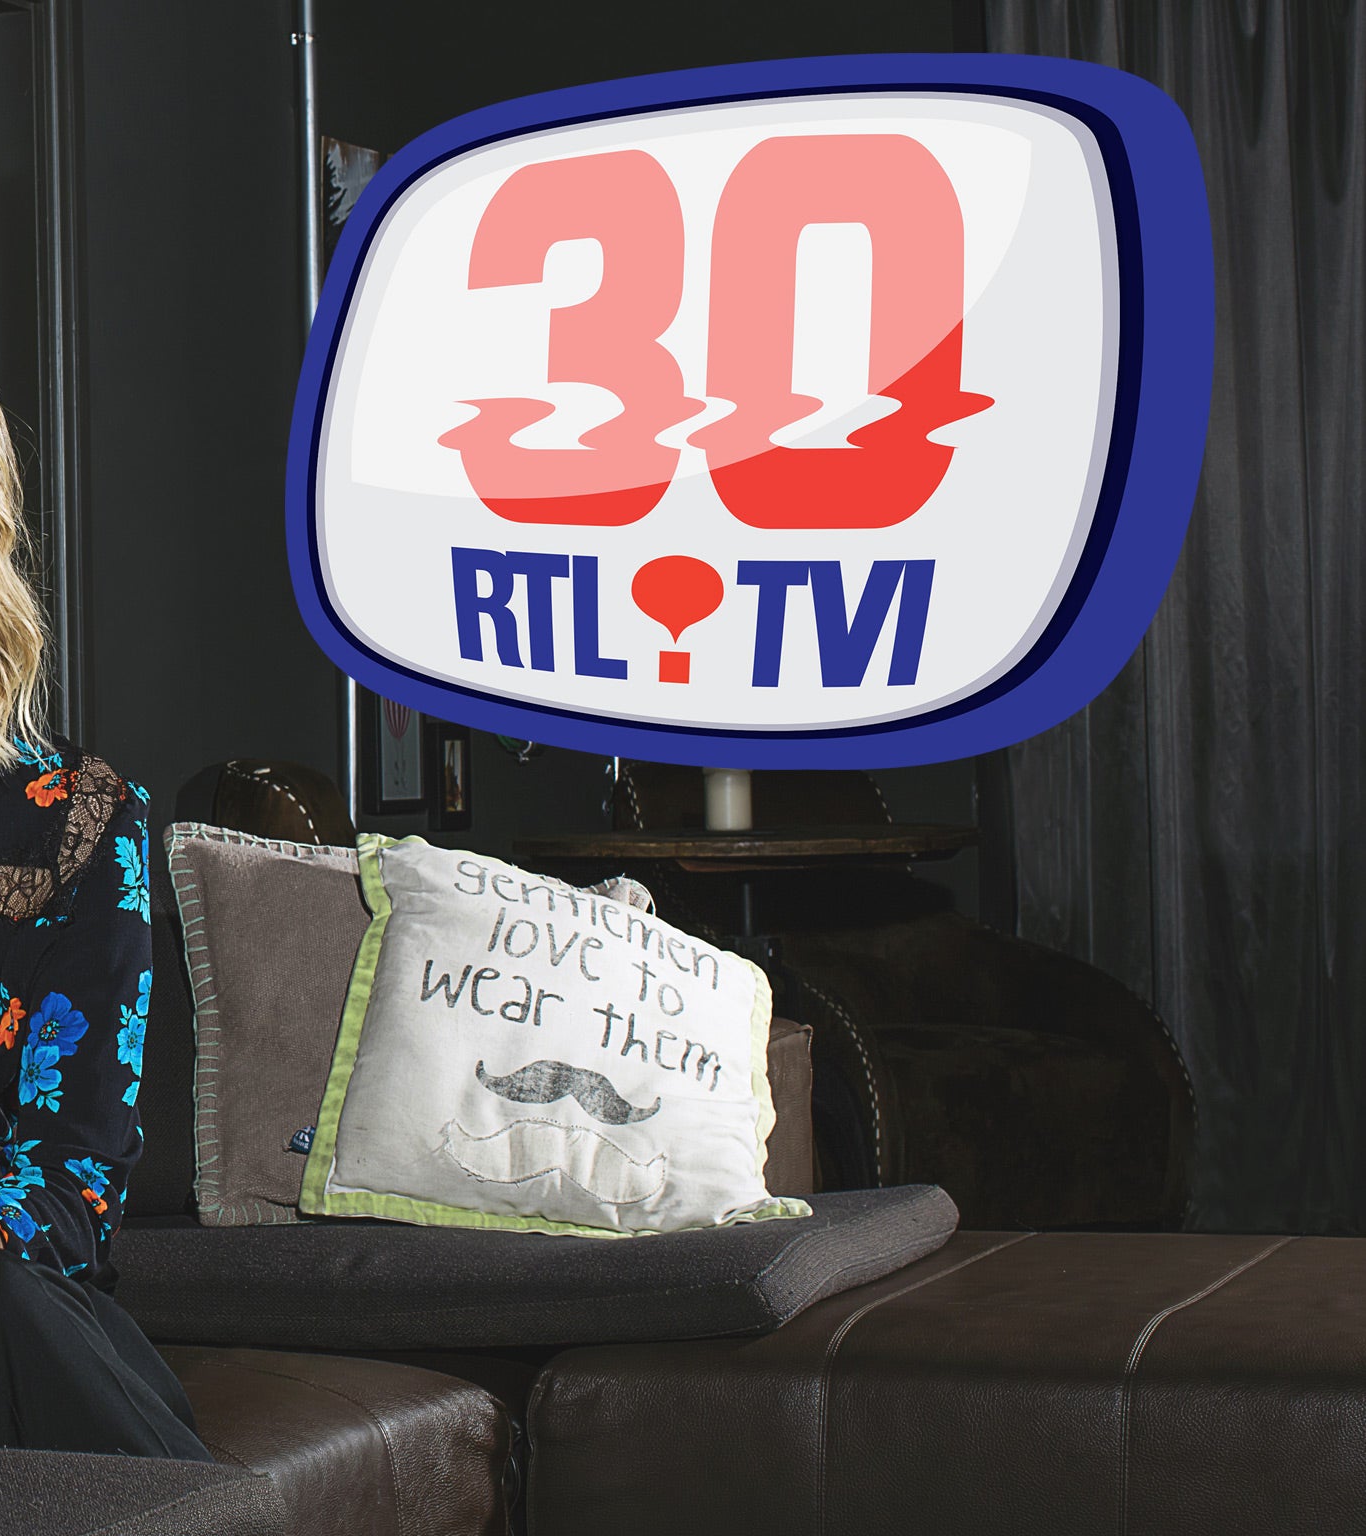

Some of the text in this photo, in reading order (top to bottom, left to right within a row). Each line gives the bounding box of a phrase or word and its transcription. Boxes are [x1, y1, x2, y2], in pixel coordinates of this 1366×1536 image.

[453, 858, 720, 991] gentlemen
[487, 906, 685, 1017] love to
[420, 958, 722, 1092] wear them
